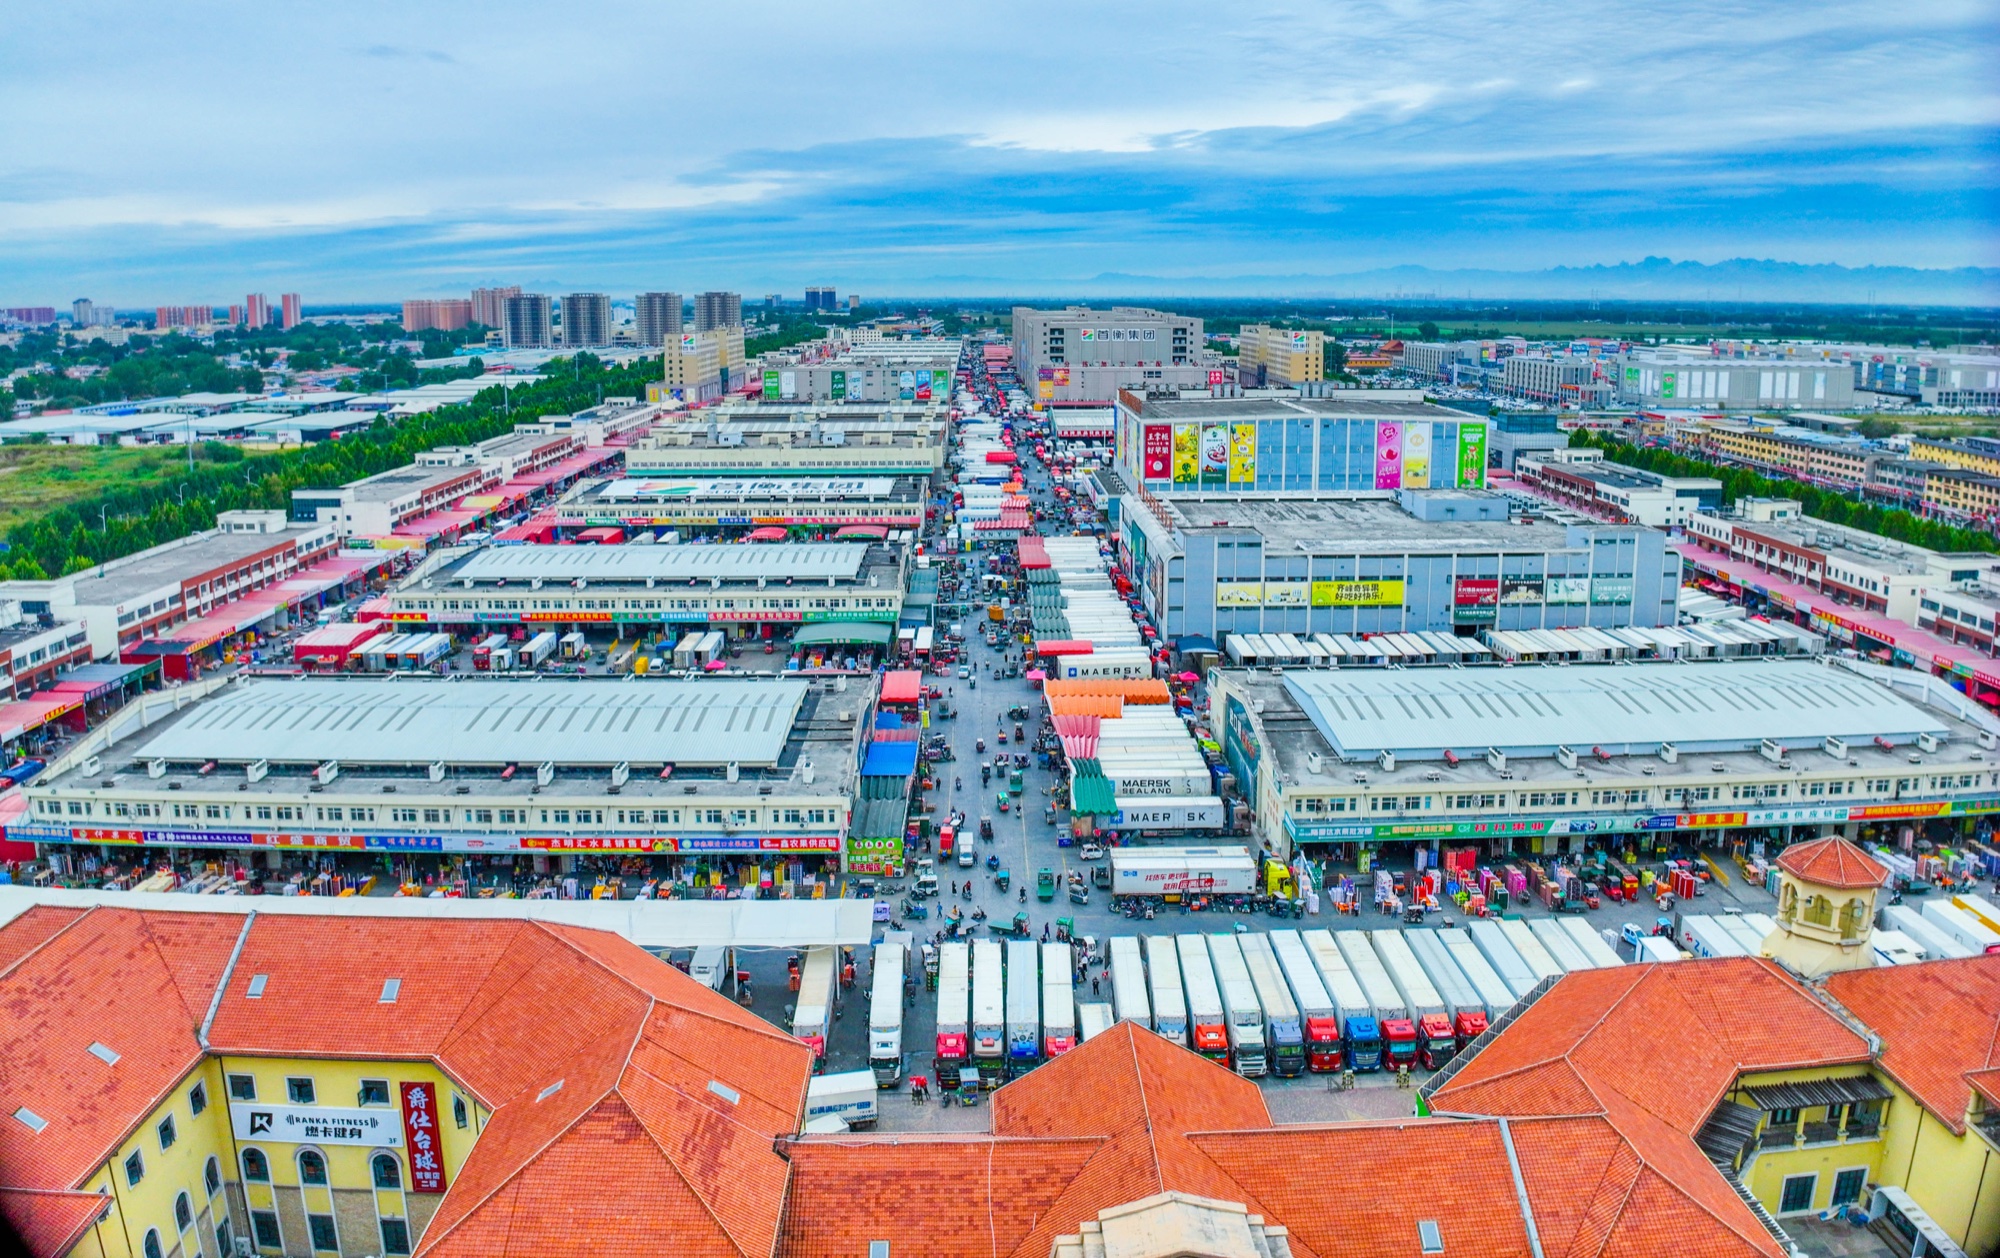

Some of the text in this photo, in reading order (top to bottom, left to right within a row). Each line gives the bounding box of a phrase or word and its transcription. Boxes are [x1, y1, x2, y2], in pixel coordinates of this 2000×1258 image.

[1097, 329, 1155, 340] 首衡集团
[1336, 583, 1379, 591] 齐峰奇异果
[1081, 666, 1142, 676] MAERSK
[1122, 779, 1171, 788] MAERSK
[551, 839, 650, 848] 杰明汇水果销售部
[780, 838, 837, 848] 鑫农果供应链
[295, 1116, 369, 1127] RANKA FITNESS
[305, 1125, 362, 1138] 燃卡健身
[407, 1086, 438, 1171] 爵仕台球
[421, 1180, 438, 1188] 二楼
